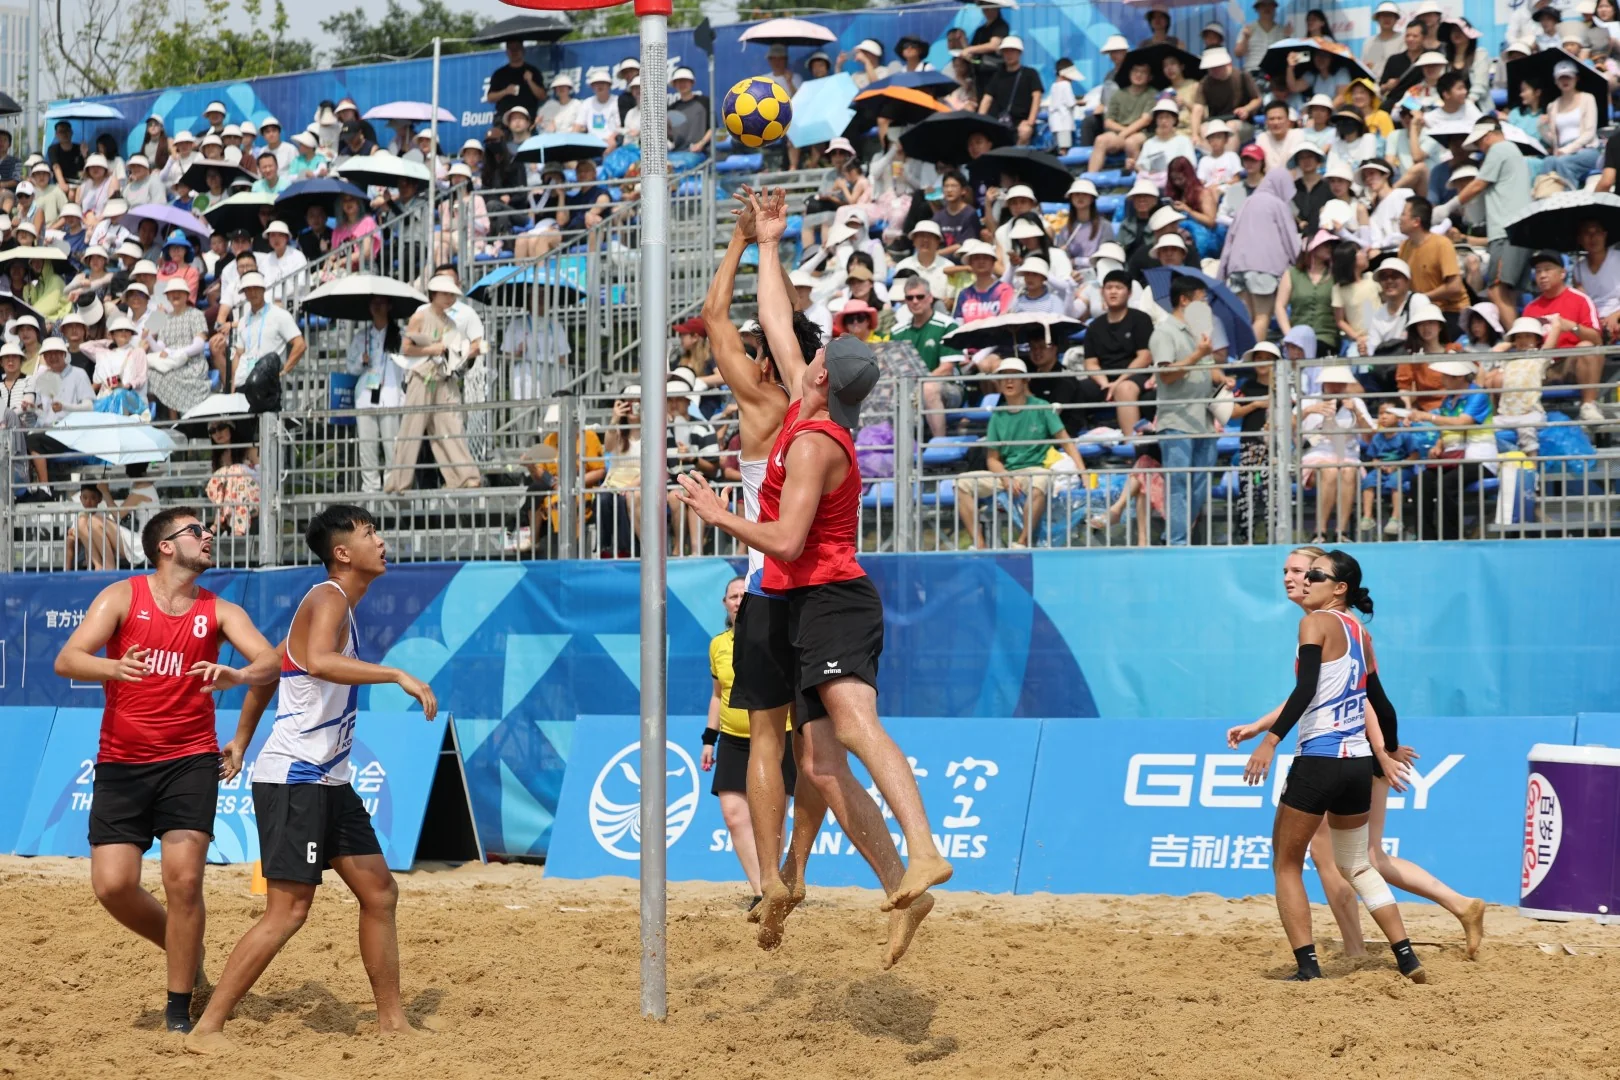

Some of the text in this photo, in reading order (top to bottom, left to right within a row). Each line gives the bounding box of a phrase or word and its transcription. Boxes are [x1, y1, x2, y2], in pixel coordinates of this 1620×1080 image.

[45, 608, 90, 629] 官方计
[193, 614, 208, 639] 8
[144, 648, 184, 677] HUN
[1123, 752, 1466, 810] GEY
[1537, 795, 1556, 866] 百岁山
[306, 841, 317, 864] 6
